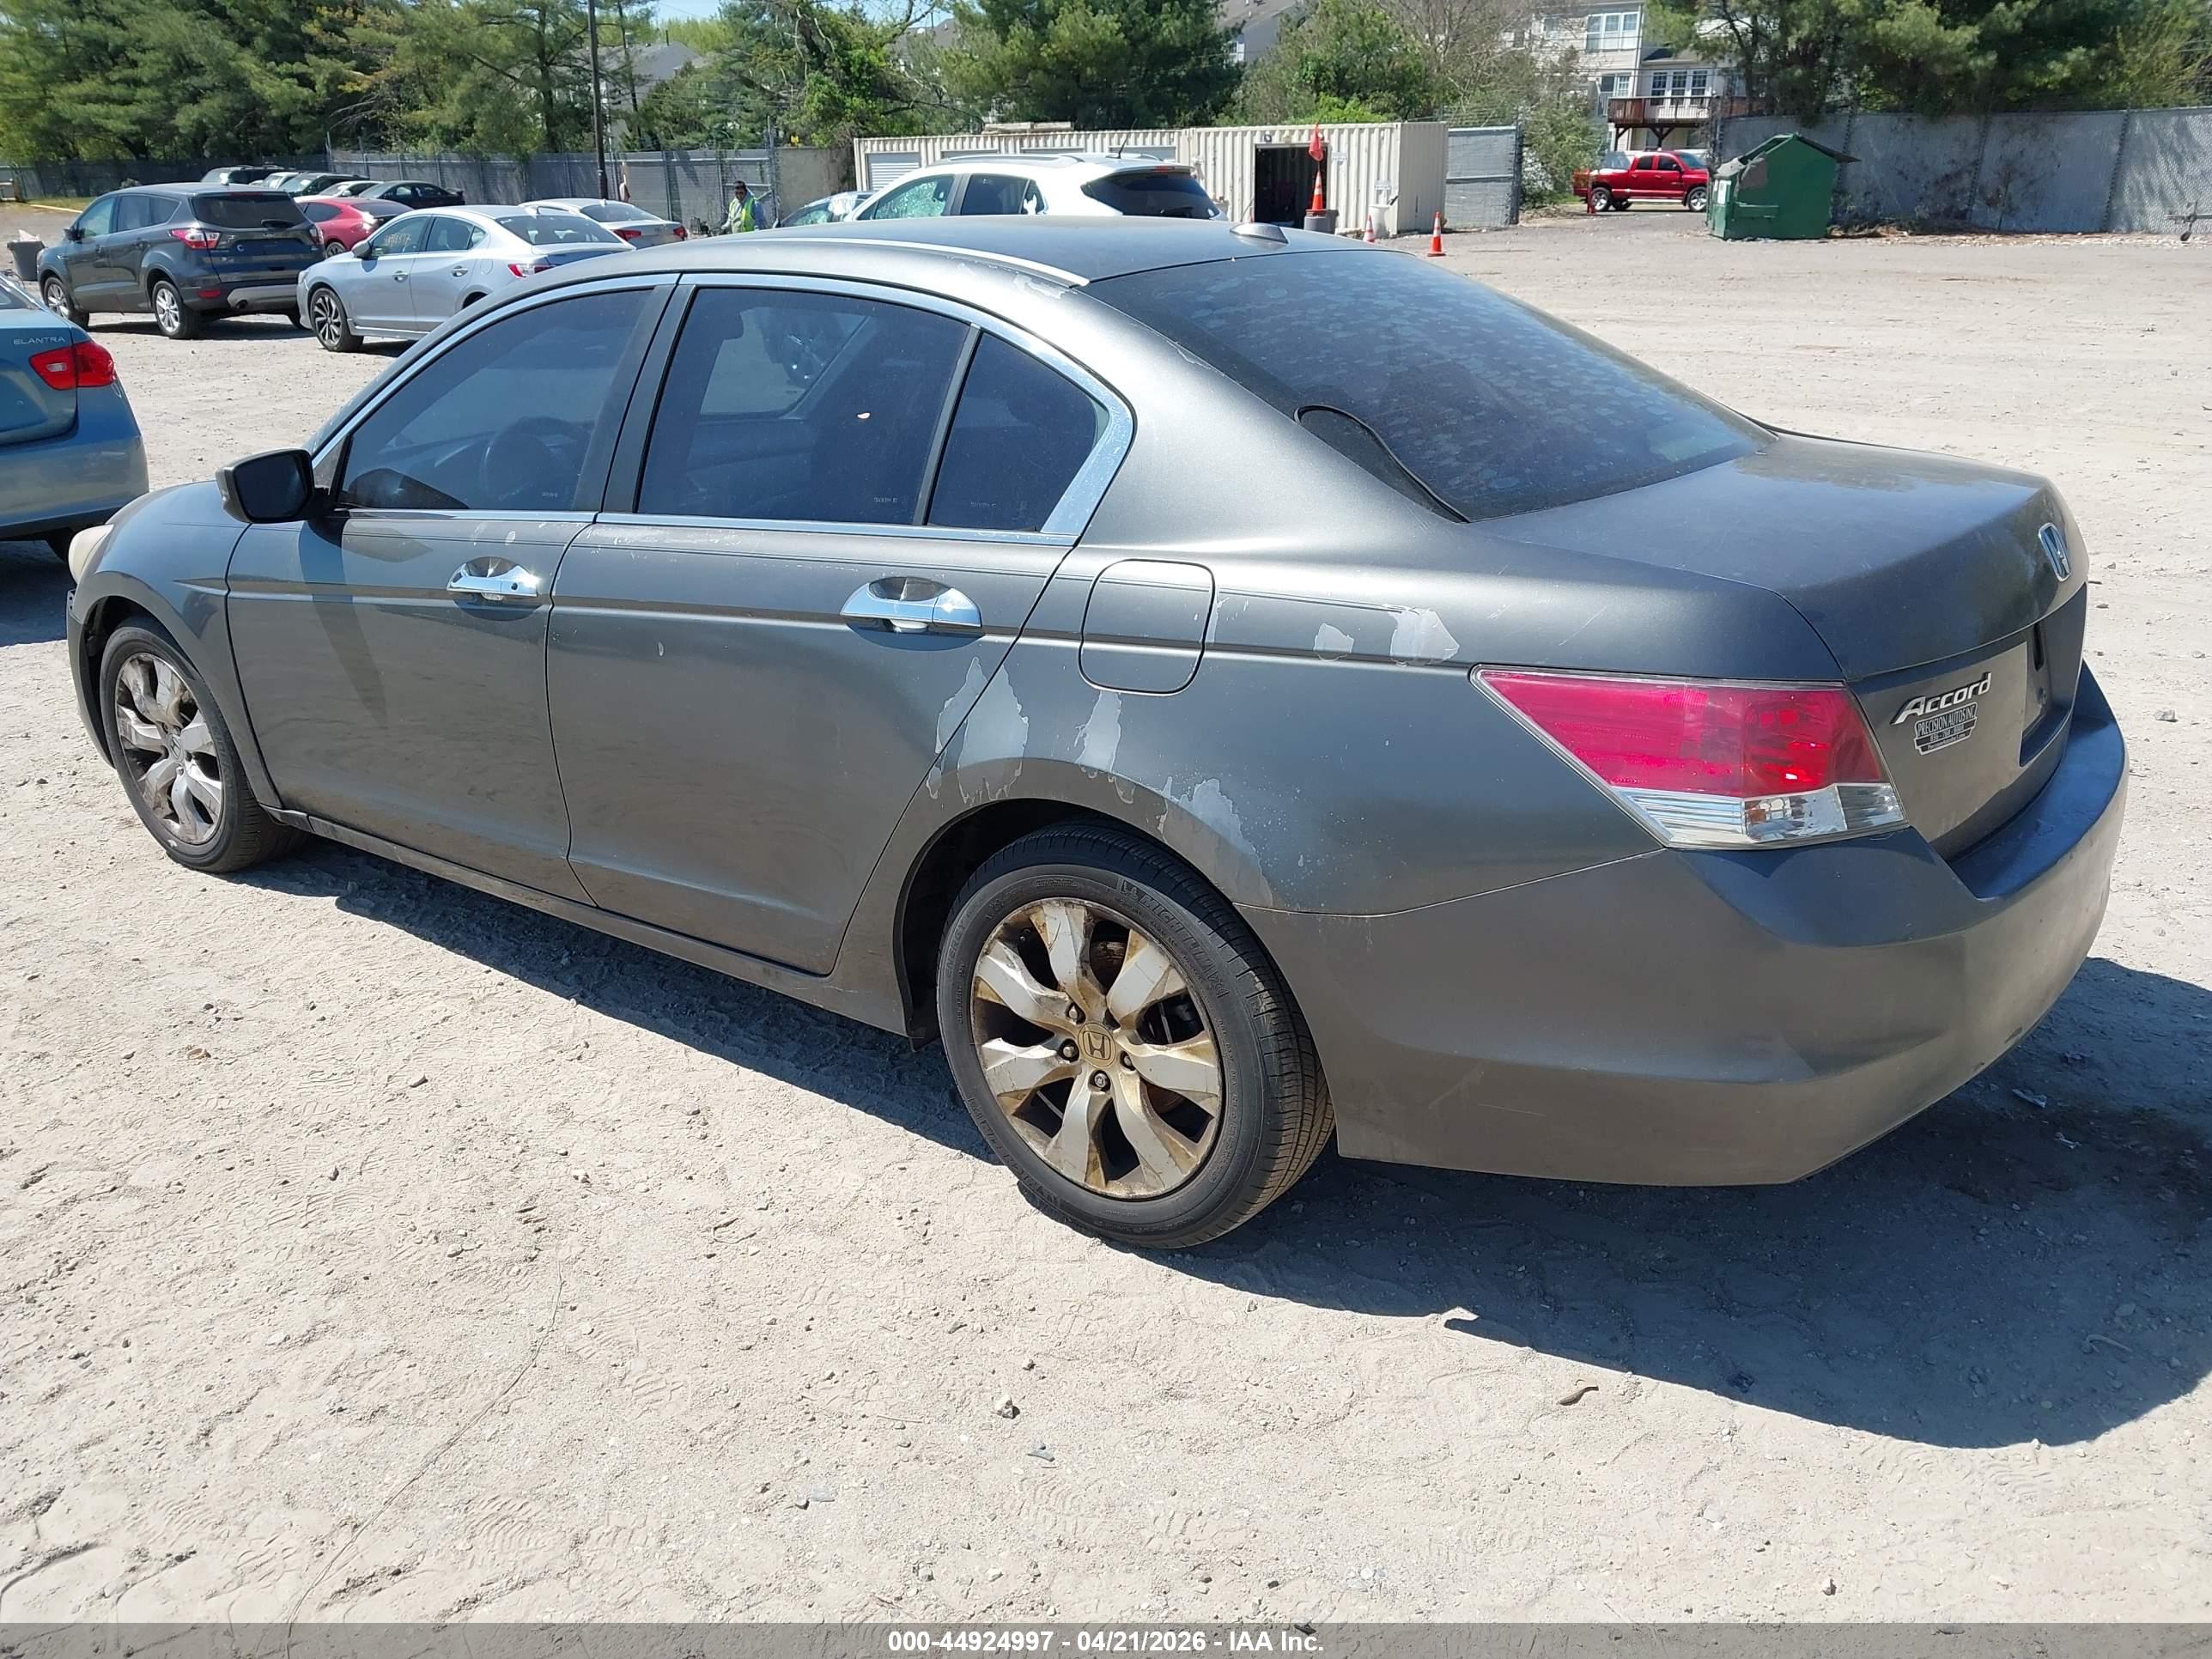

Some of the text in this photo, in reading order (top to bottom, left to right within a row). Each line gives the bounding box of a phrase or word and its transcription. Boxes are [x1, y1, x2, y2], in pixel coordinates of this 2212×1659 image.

[14, 336, 66, 345] ELANTRA
[1891, 672, 1992, 725] Accord
[1917, 715, 1948, 737] PRECISION
[1948, 708, 1966, 726] AUTOS
